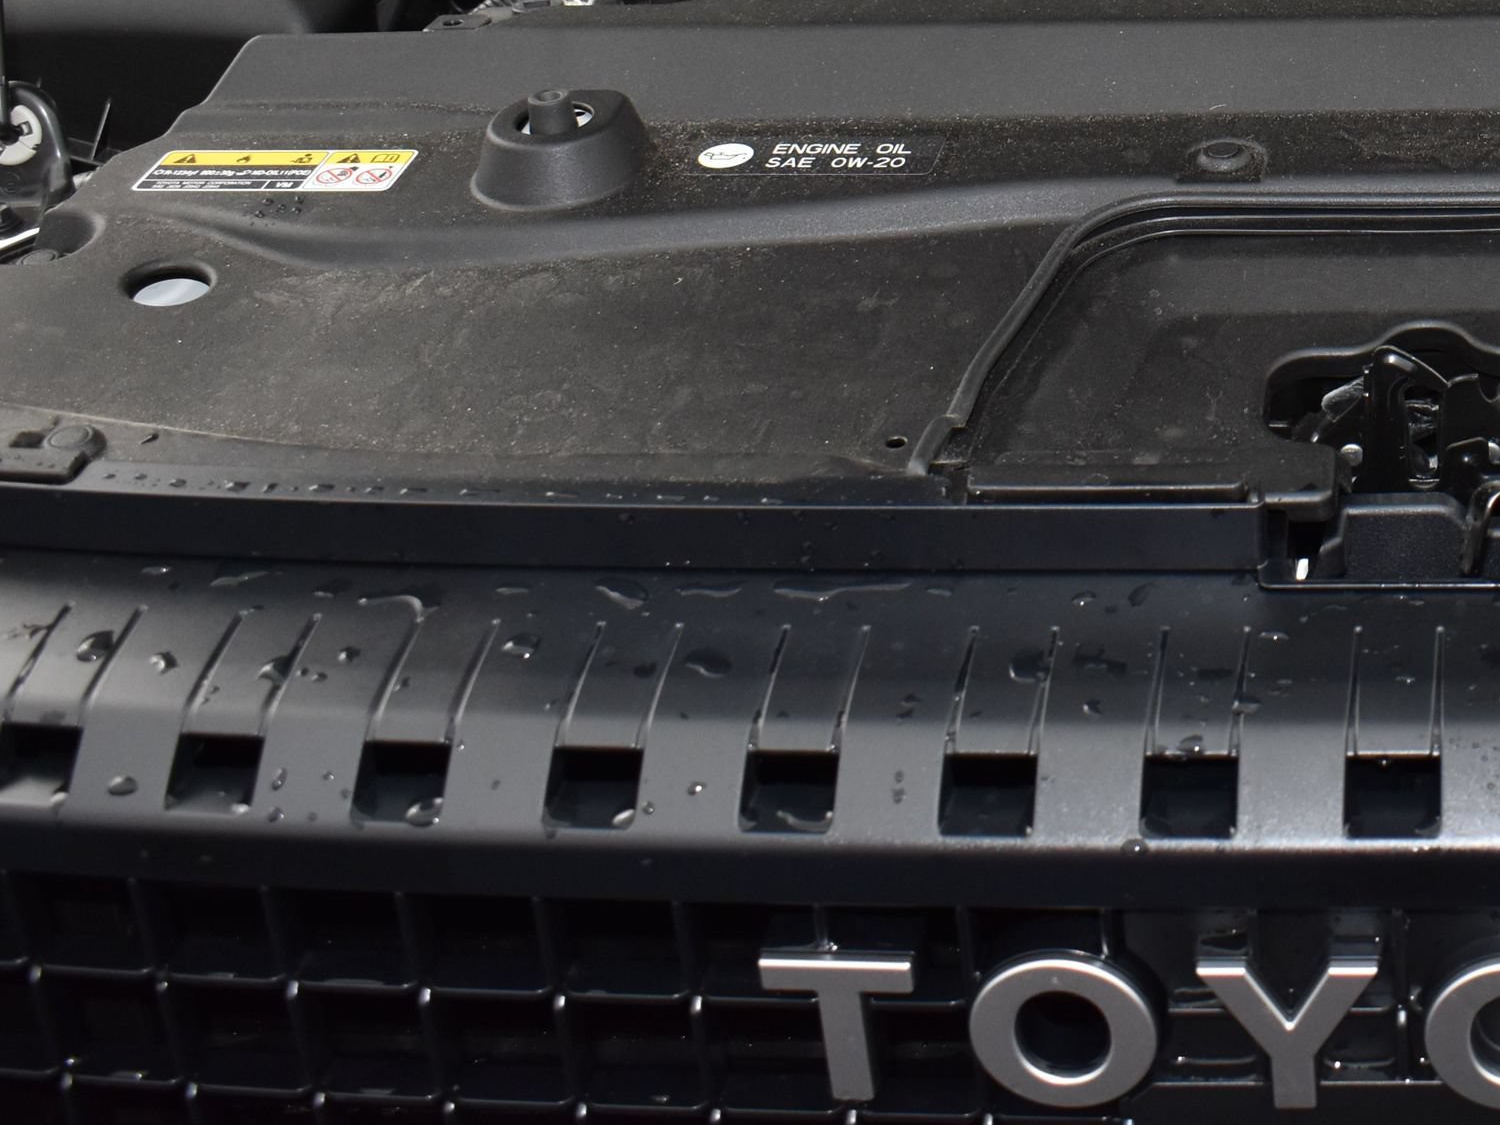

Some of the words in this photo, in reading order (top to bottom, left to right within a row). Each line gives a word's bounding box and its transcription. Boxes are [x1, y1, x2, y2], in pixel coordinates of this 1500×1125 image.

[773, 143, 861, 155] ENGINE
[875, 143, 912, 155] OIL
[765, 157, 815, 168] SAE
[831, 157, 906, 168] 0W-20
